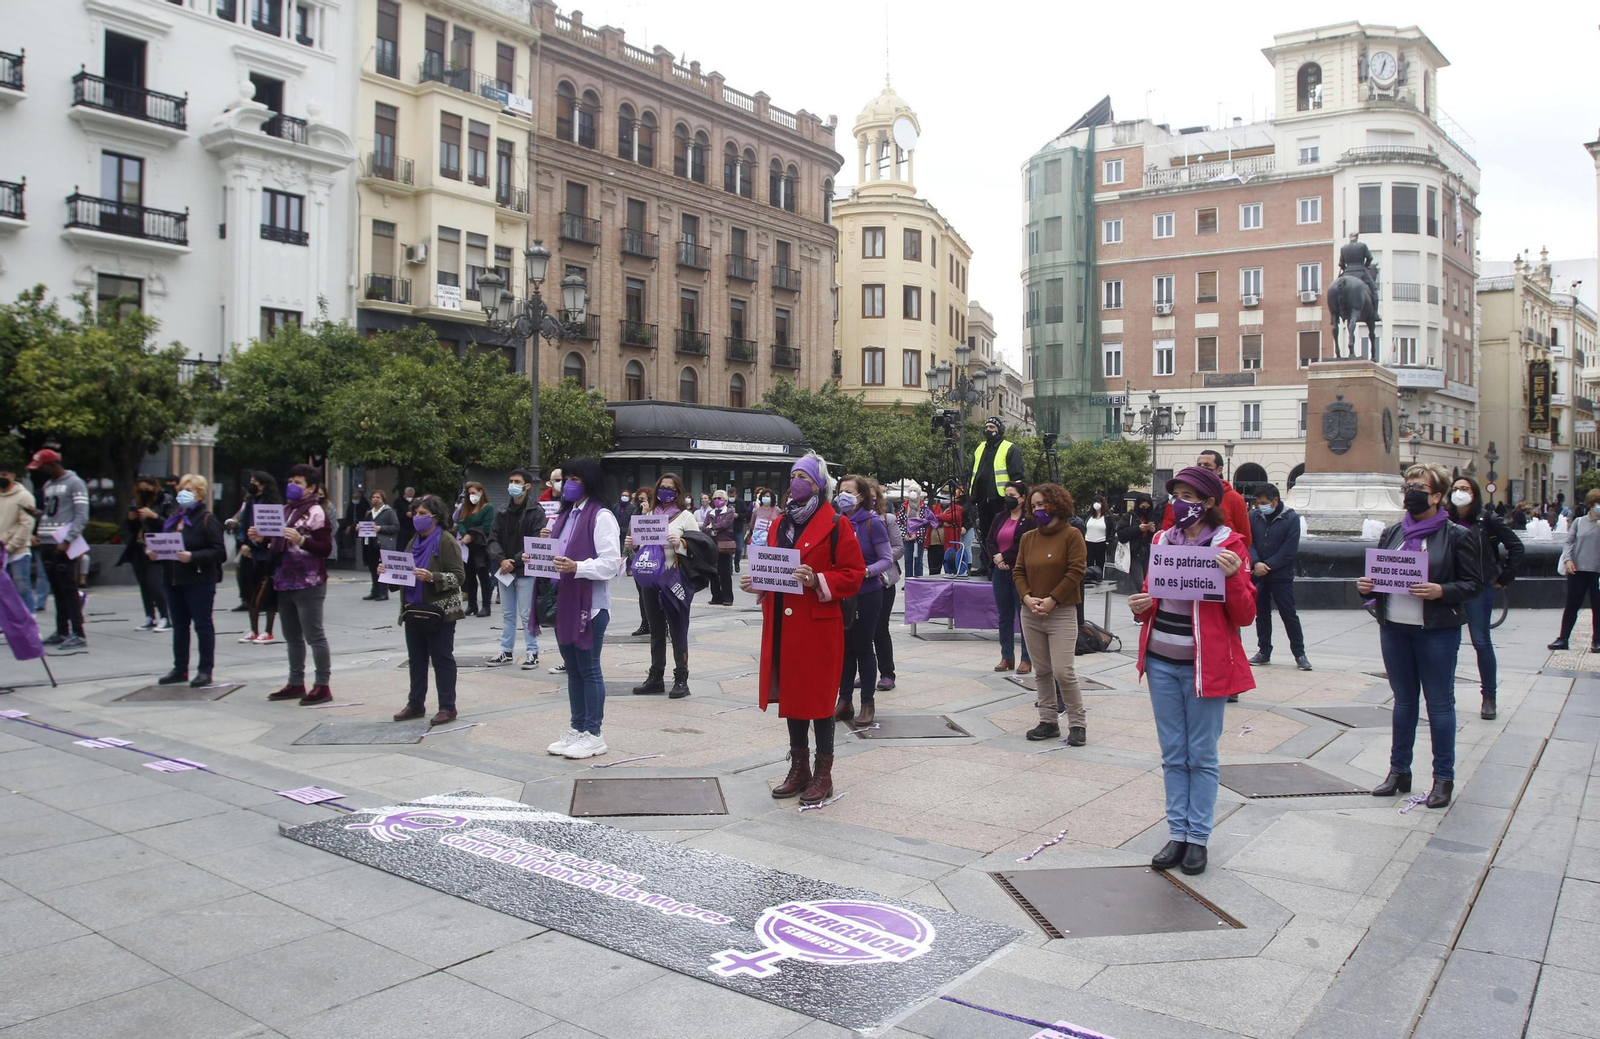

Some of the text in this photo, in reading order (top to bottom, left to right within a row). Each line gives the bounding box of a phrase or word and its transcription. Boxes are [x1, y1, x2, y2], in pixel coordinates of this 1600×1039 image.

[1091, 396, 1125, 404] HOTEL
[1534, 376, 1545, 420] EMFISA
[758, 552, 781, 561] DENUNCIAMOS
[1154, 554, 1162, 565] Si
[1164, 557, 1174, 566] es
[1376, 555, 1416, 564] REIVINDICAMOS
[1399, 569, 1422, 578] CALIDAD,
[1155, 576, 1216, 590] no es justicia.
[471, 830, 643, 884] Plataforma Cordobesa
[499, 850, 514, 862] la
[517, 855, 594, 888] Violencia
[596, 881, 613, 892] a
[613, 884, 643, 899] las
[643, 894, 732, 924] Mujeres
[776, 904, 916, 958] EMERGENCIA
[779, 926, 849, 954] FEMINISTA
